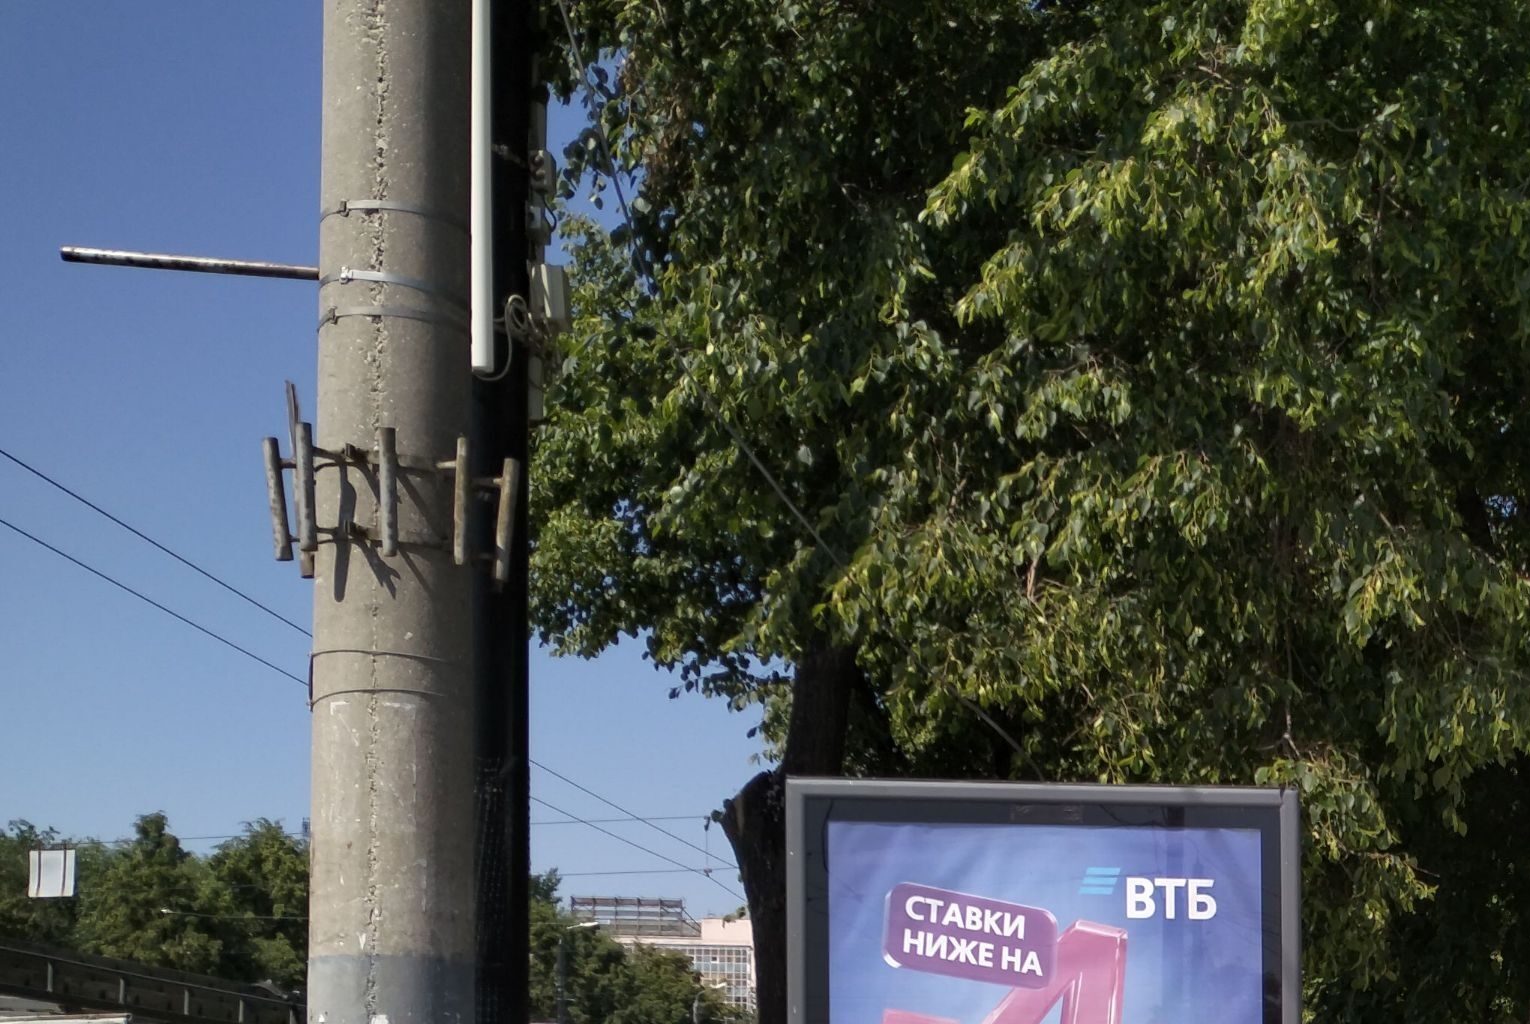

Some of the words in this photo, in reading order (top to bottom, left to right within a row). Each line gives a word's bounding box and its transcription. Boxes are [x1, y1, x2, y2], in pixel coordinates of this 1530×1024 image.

[904, 895, 1025, 940] СТАВКИ
[1125, 877, 1217, 920] ВТБ
[902, 928, 993, 968] НИЖЕ
[1001, 942, 1043, 977] НА
